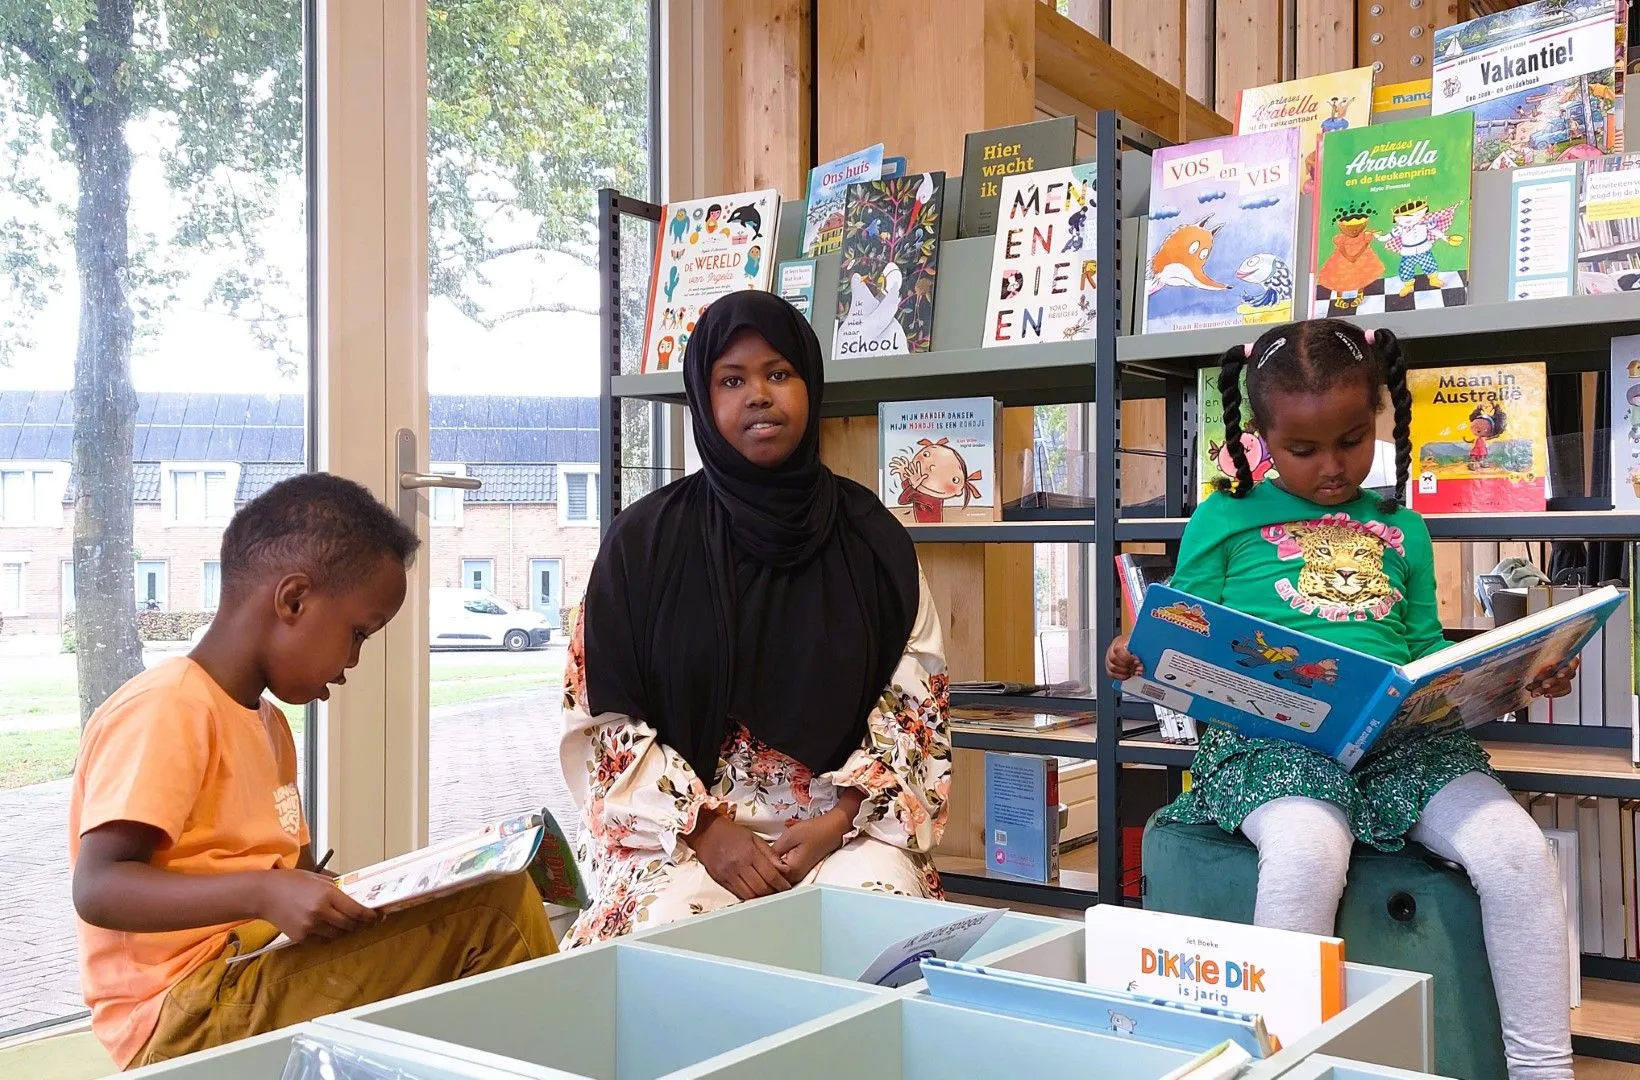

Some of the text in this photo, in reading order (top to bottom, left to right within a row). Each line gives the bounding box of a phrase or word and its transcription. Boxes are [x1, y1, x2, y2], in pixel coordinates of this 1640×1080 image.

[1481, 37, 1574, 86] Vakantie!
[1252, 94, 1319, 122] Arabella
[1268, 95, 1300, 108] prinses
[983, 142, 1021, 160] Hier
[1345, 140, 1439, 176] Arabella
[1370, 140, 1413, 157] prinses
[822, 171, 844, 186] Ons
[846, 160, 870, 178] huis
[982, 156, 1034, 178] wacht
[1170, 157, 1280, 187] VOS en VIS
[1345, 167, 1437, 186] en de keukenprins
[980, 182, 998, 198] ik
[1005, 224, 1053, 260] EN
[684, 252, 741, 272] DE WERELD
[1000, 260, 1096, 300] DIER
[996, 306, 1044, 340] EN
[840, 332, 898, 354] school
[1439, 371, 1516, 388] Maan in
[1433, 386, 1522, 404] Australië
[909, 422, 934, 430] MONDJE
[920, 412, 946, 420] HANDEN
[1186, 938, 1218, 948] Jet Boeke
[1142, 948, 1266, 993] Dikkie Dik
[1178, 984, 1228, 1006] is jarig
